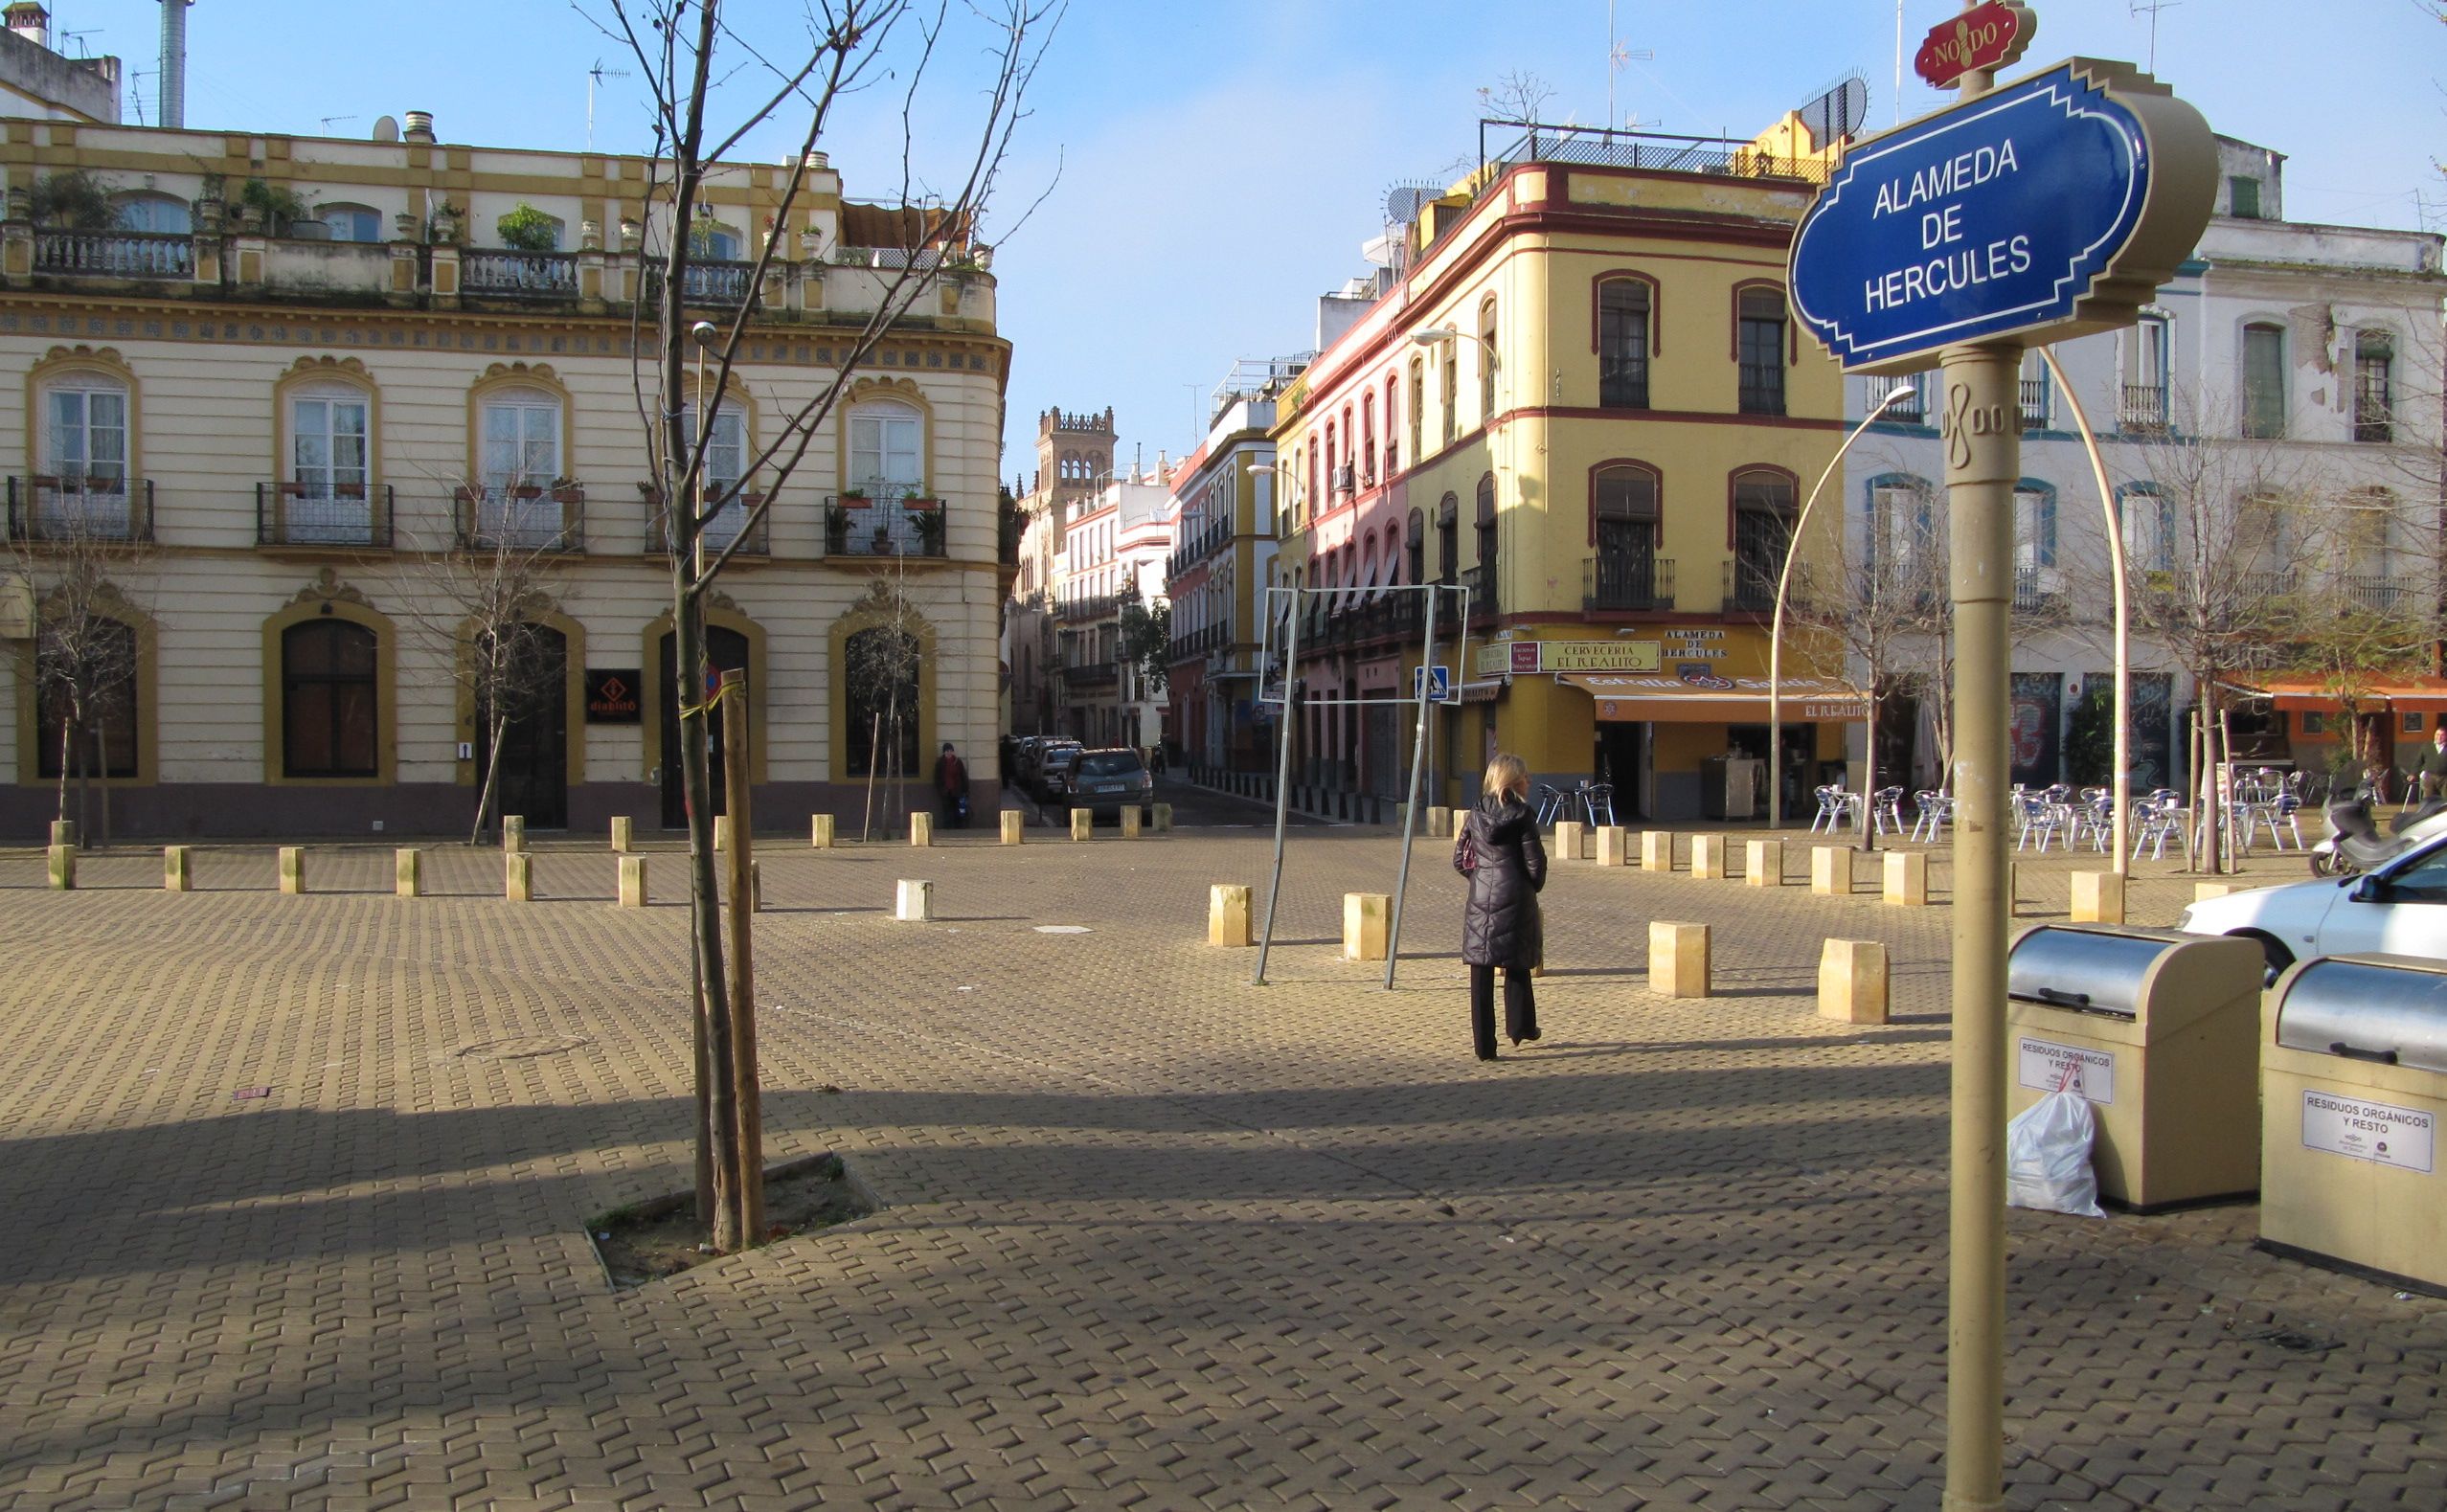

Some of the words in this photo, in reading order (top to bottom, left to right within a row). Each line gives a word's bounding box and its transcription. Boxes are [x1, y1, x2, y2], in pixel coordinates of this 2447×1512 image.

[1872, 138, 2018, 220] ALAMEDA
[1922, 204, 1963, 250] DE
[1865, 235, 2031, 314] HERCULES
[1665, 630, 1724, 640] ALAMEDA
[1564, 645, 1634, 656] CERVECERIA
[1557, 657, 1571, 667] EL
[1577, 657, 1643, 667] REALITO
[1586, 677, 1682, 688] Estrella
[1805, 705, 1817, 716] EL
[2022, 1043, 2061, 1057] RESIDUOS
[2049, 1059, 2054, 1068] Y
[2055, 1060, 2081, 1072] RESTO
[2306, 1096, 2360, 1116] RESIDUOS
[2362, 1107, 2429, 1129] ORGÁNICOS
[2343, 1116, 2350, 1126] Y
[2352, 1118, 2389, 1134] RESTO
